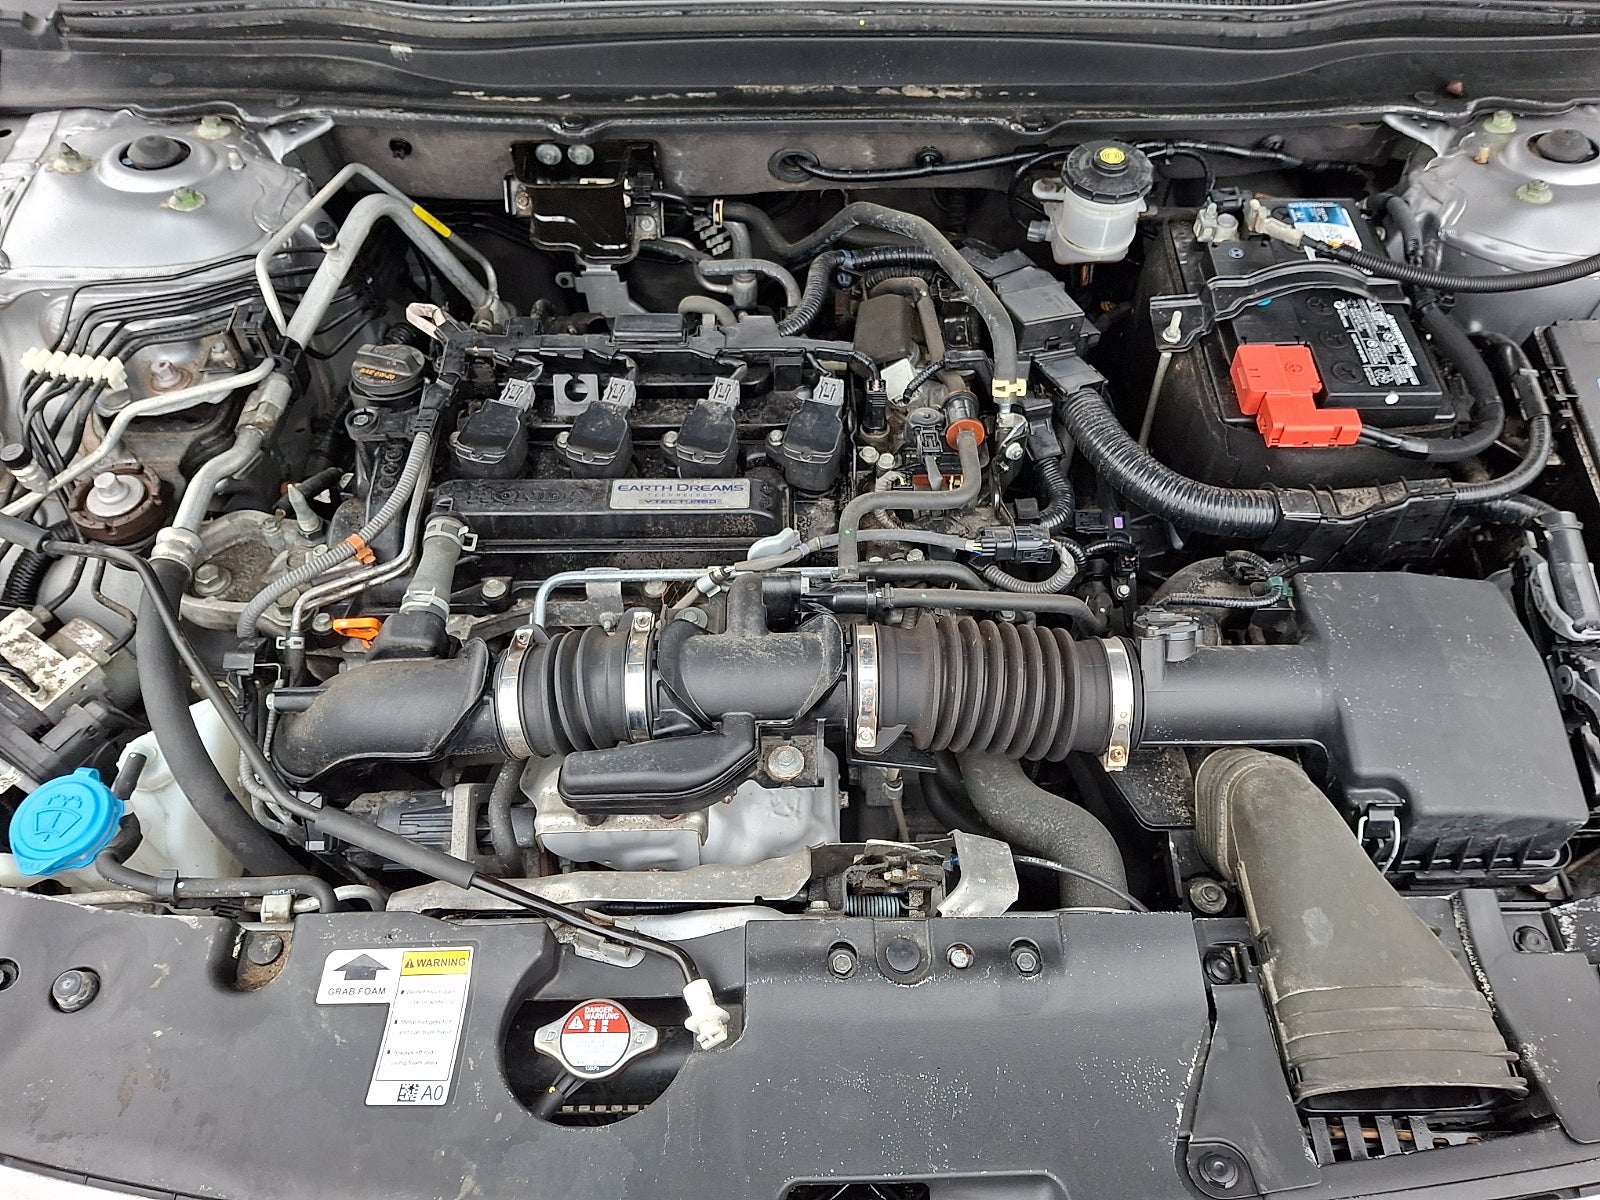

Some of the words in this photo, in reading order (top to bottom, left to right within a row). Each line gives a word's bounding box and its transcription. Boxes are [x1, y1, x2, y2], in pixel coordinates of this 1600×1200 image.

[617, 484, 673, 492] EARTH
[676, 483, 744, 492] DREAMS
[465, 487, 591, 503] HONDA
[416, 957, 467, 968] WARNING
[327, 987, 356, 996] GRAB
[357, 987, 387, 996] FOAM
[584, 1006, 614, 1014] DANGER
[420, 1084, 444, 1101] A0
